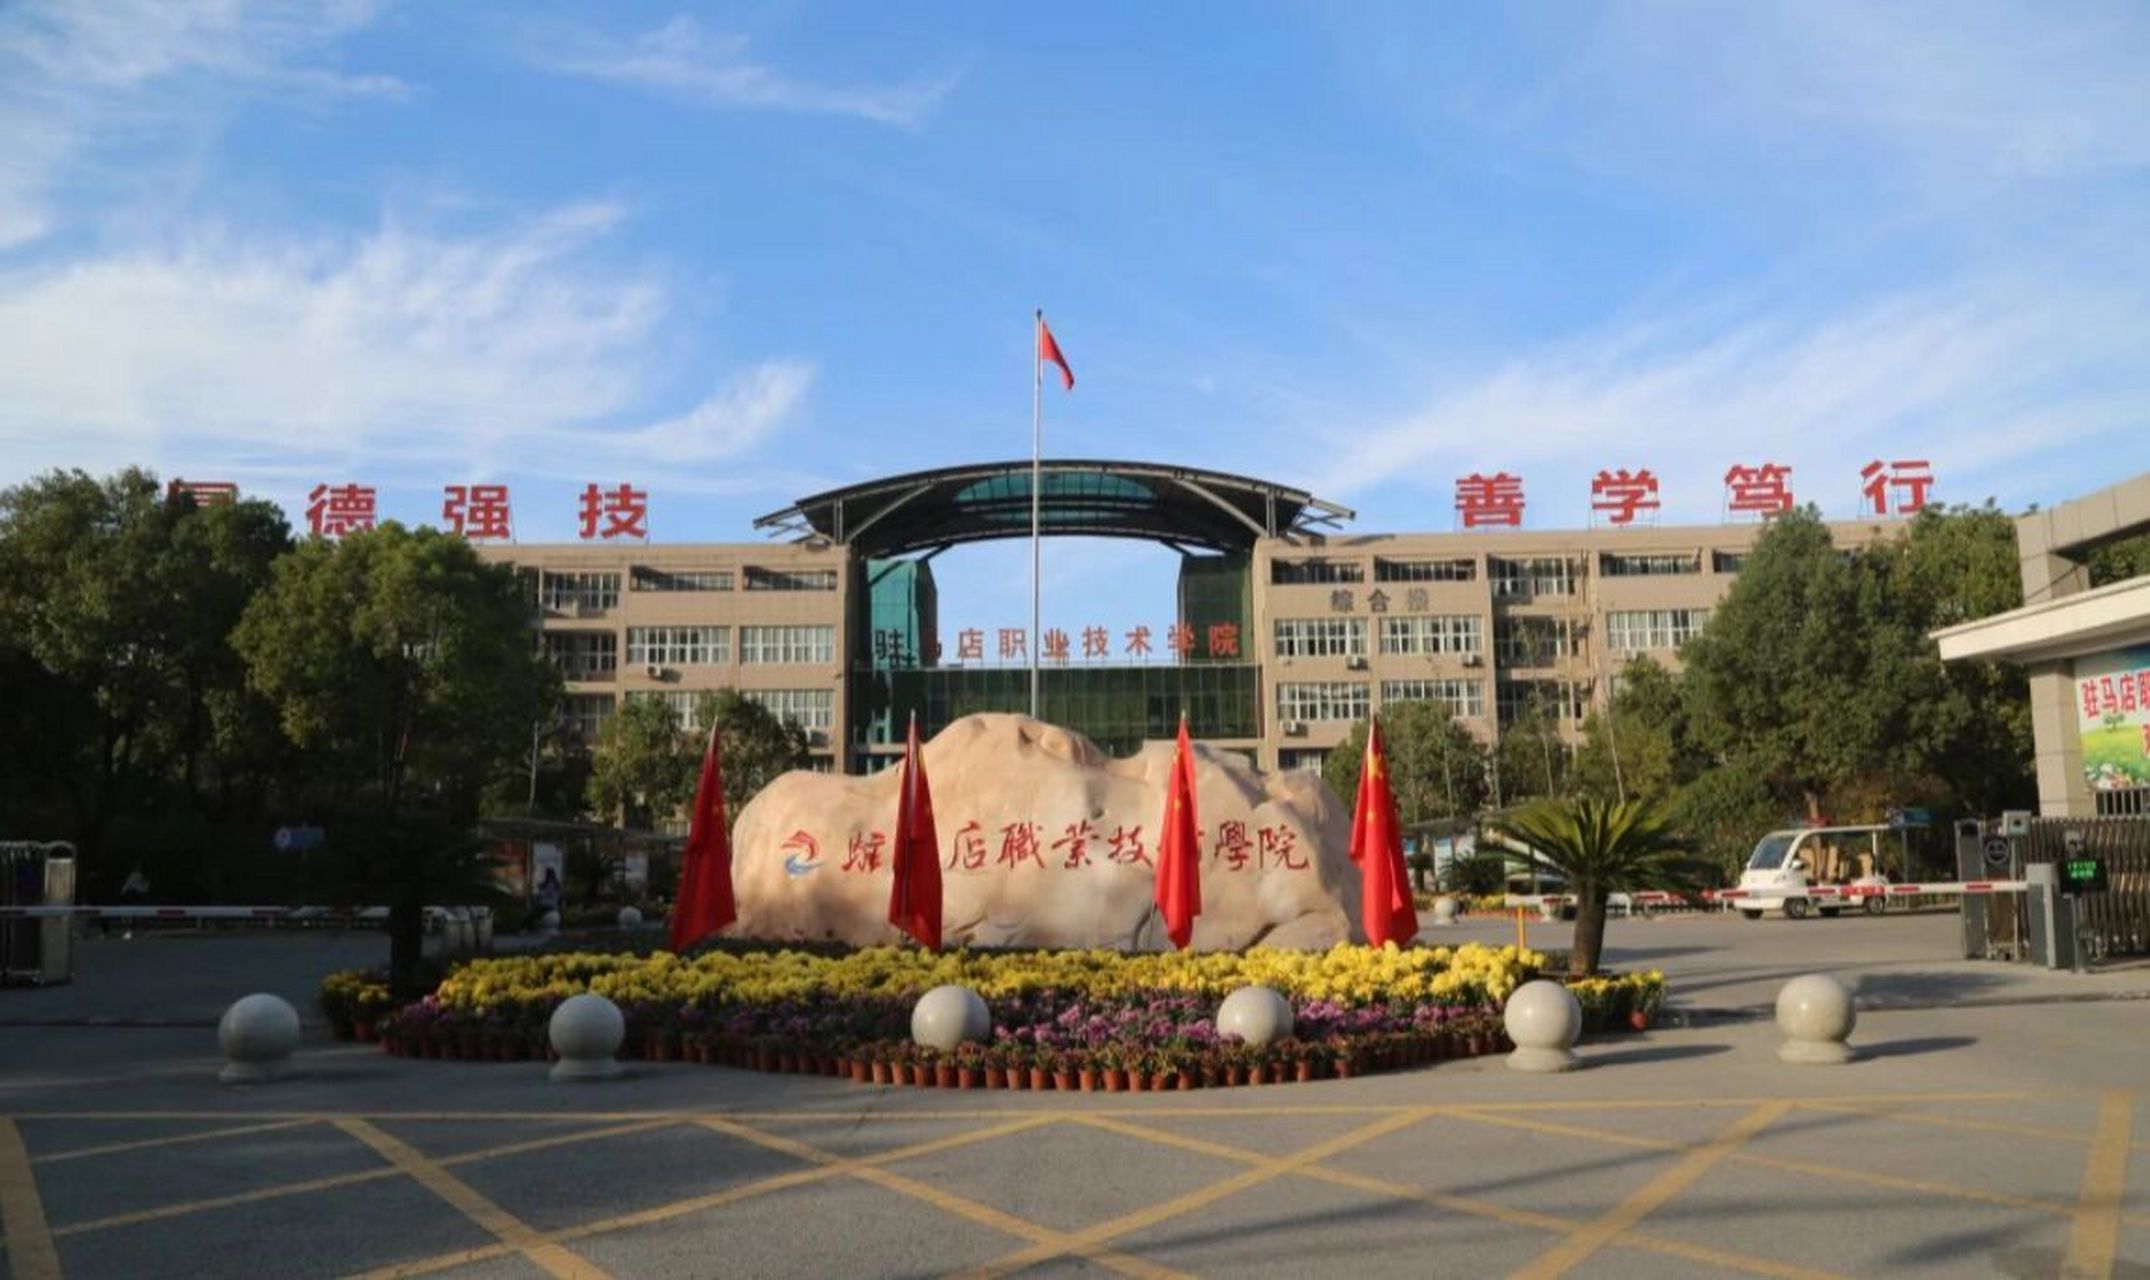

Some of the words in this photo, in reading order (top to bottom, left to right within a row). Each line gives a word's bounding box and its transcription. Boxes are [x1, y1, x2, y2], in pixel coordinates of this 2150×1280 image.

[1455, 460, 1934, 527] 善学笃行
[875, 625, 1240, 668] 驻店职业技术学院
[841, 821, 1310, 871] 駐店職業技學院
